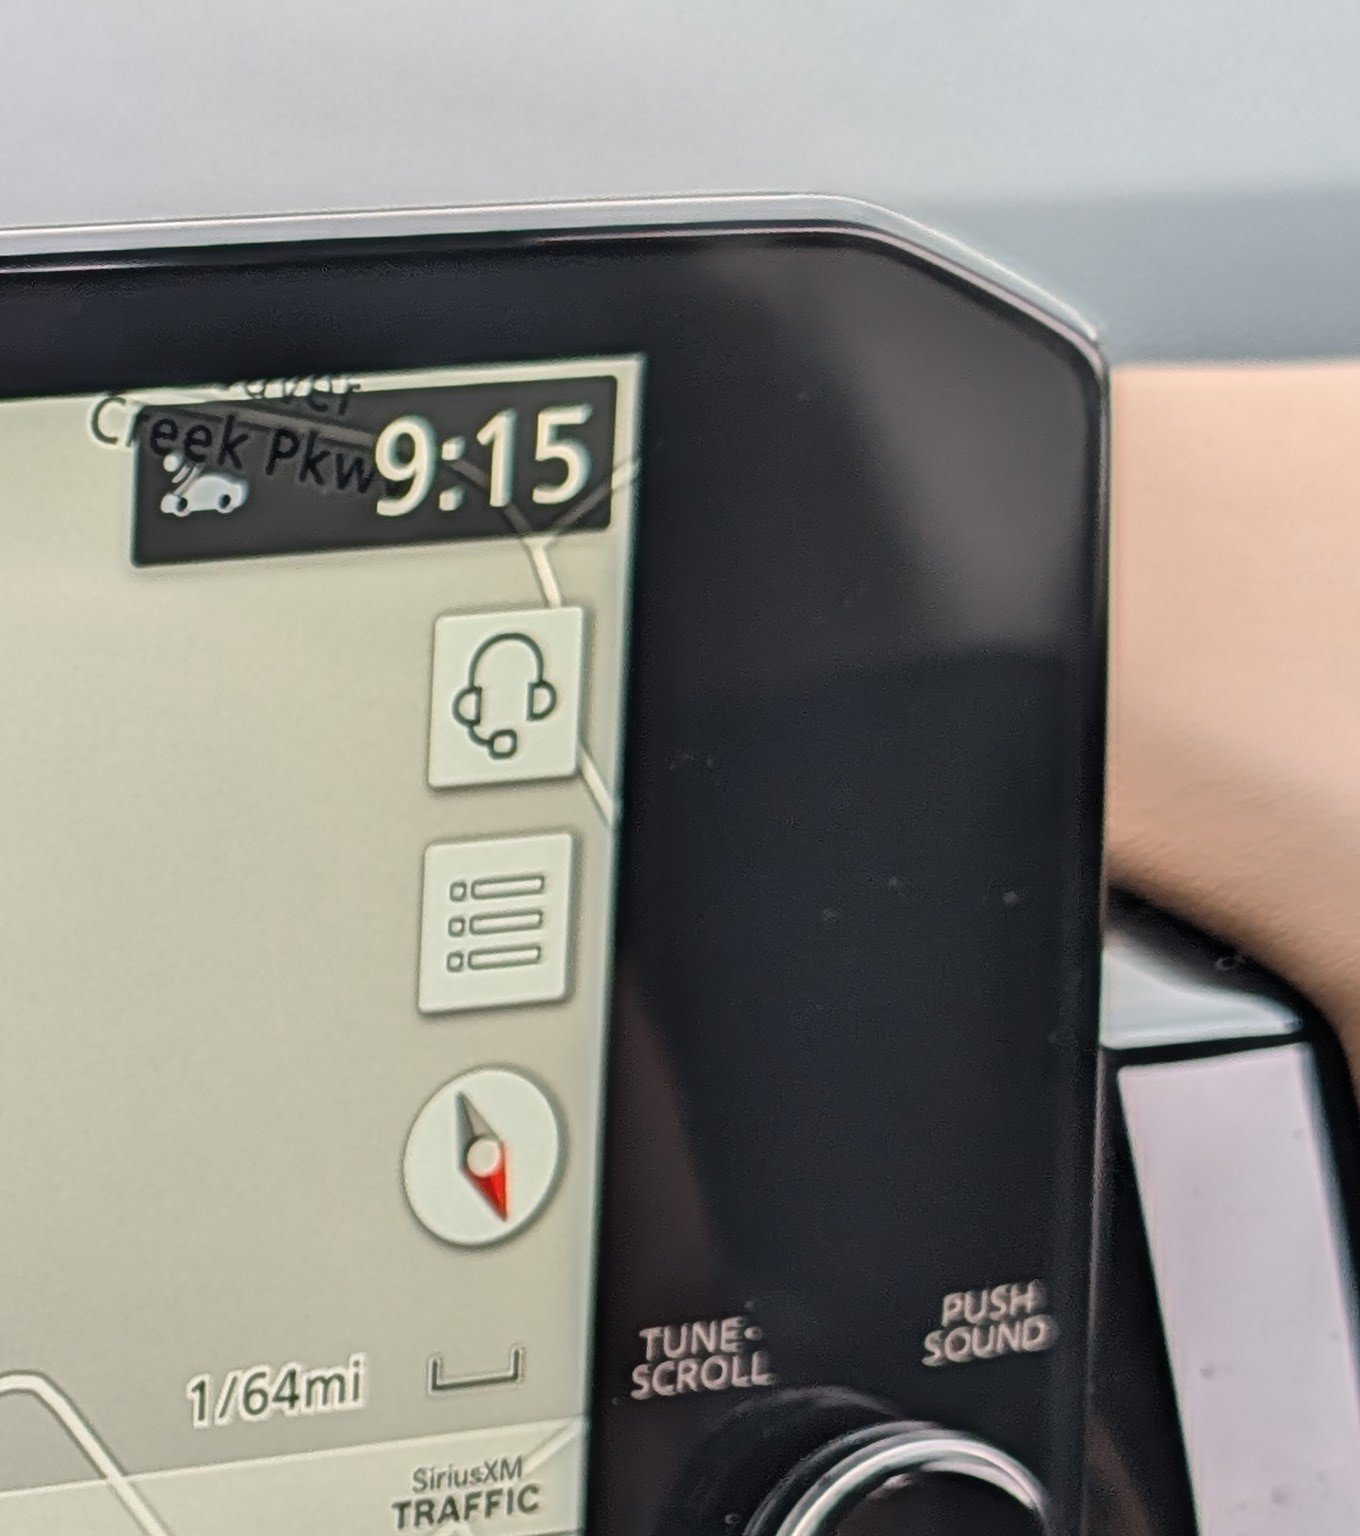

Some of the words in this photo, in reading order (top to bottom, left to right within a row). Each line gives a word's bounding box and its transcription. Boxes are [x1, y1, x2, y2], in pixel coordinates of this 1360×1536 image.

[266, 427, 404, 496] Pkw
[376, 404, 592, 517] 9:15
[941, 1279, 1045, 1326] PUSH
[921, 1313, 1055, 1367] SOUND
[190, 1359, 362, 1422] 1/64mi
[630, 1350, 776, 1400] SCROLL
[412, 1456, 524, 1493] SiriusXM
[392, 1484, 541, 1530] TRAFFIC
